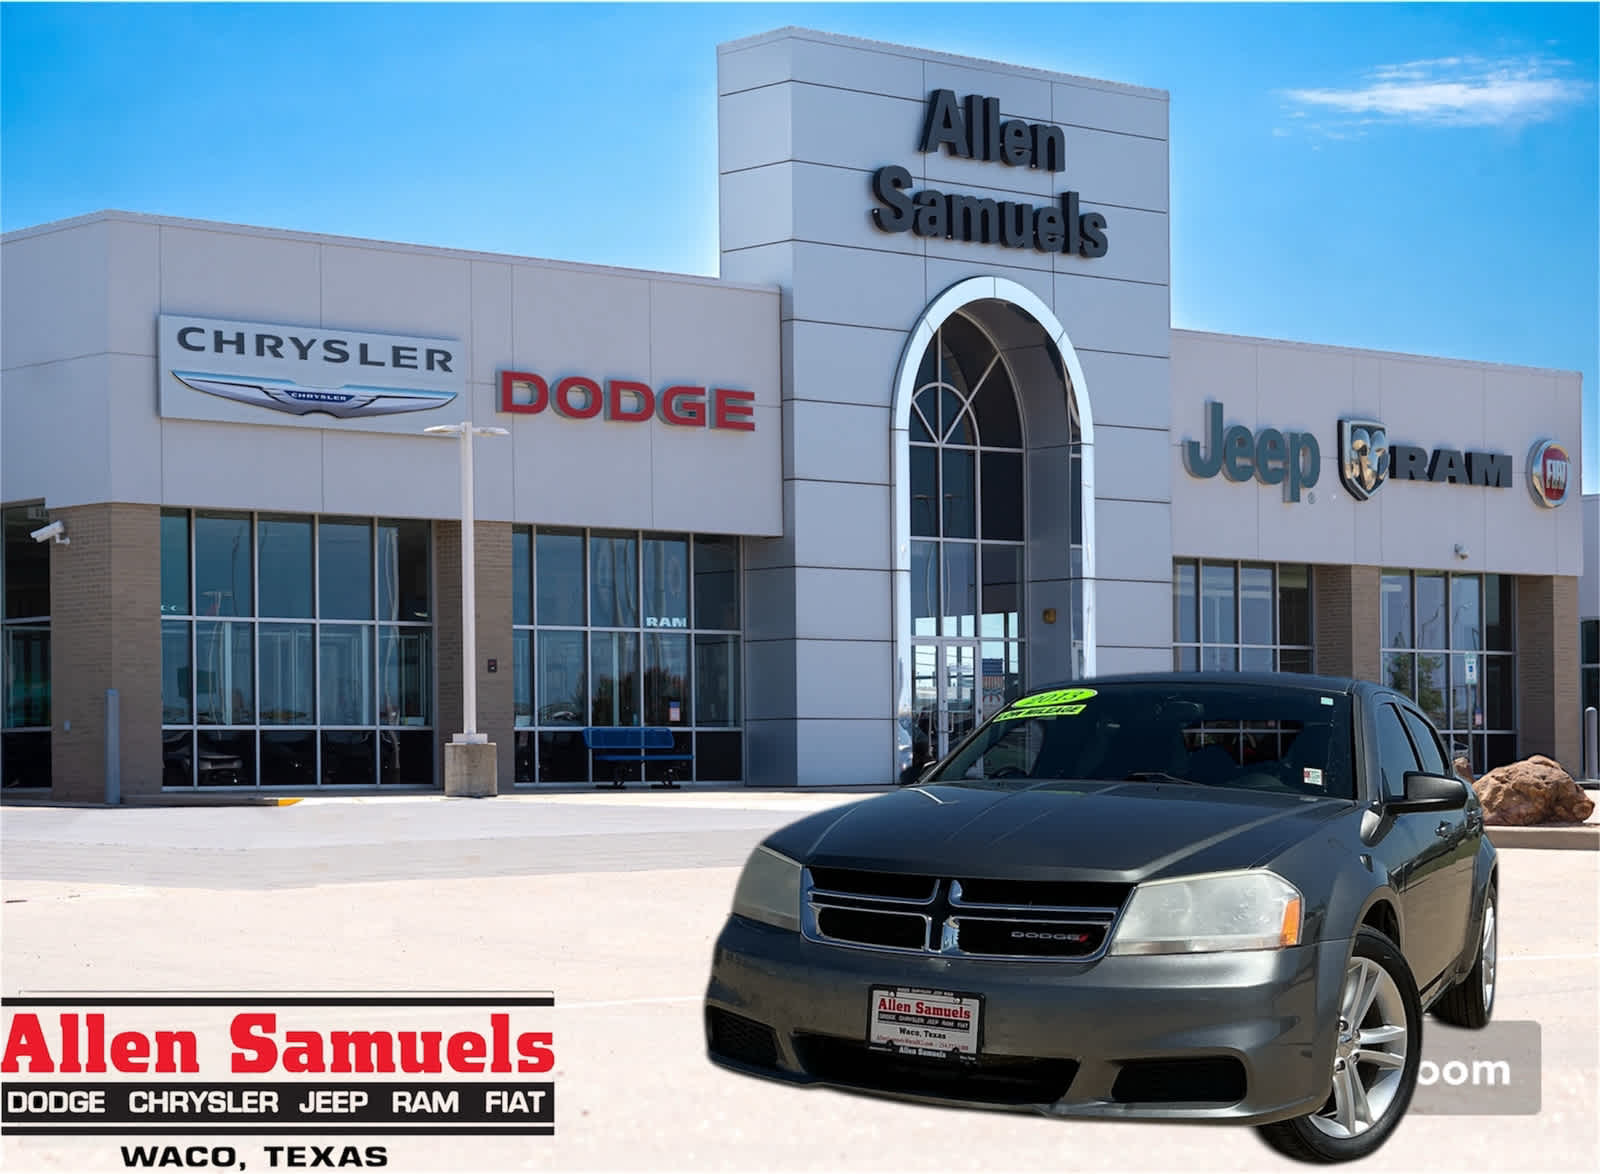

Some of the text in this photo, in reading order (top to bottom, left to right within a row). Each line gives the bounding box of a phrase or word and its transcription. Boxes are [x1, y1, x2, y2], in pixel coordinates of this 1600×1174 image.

[920, 88, 1065, 172] Allen
[872, 165, 1108, 258] Samuels
[177, 326, 454, 373] CHRYSLER
[290, 391, 348, 402] CHRYSLER
[496, 370, 755, 432] DODGE
[1183, 401, 1321, 503] Jeep
[1389, 445, 1513, 488] RAM
[1546, 458, 1568, 490] FIAT
[646, 616, 687, 628] RAM
[1011, 931, 1081, 941] DODGE
[878, 997, 971, 1019] Allen Samuels
[899, 1027, 947, 1040] Waco, Texas
